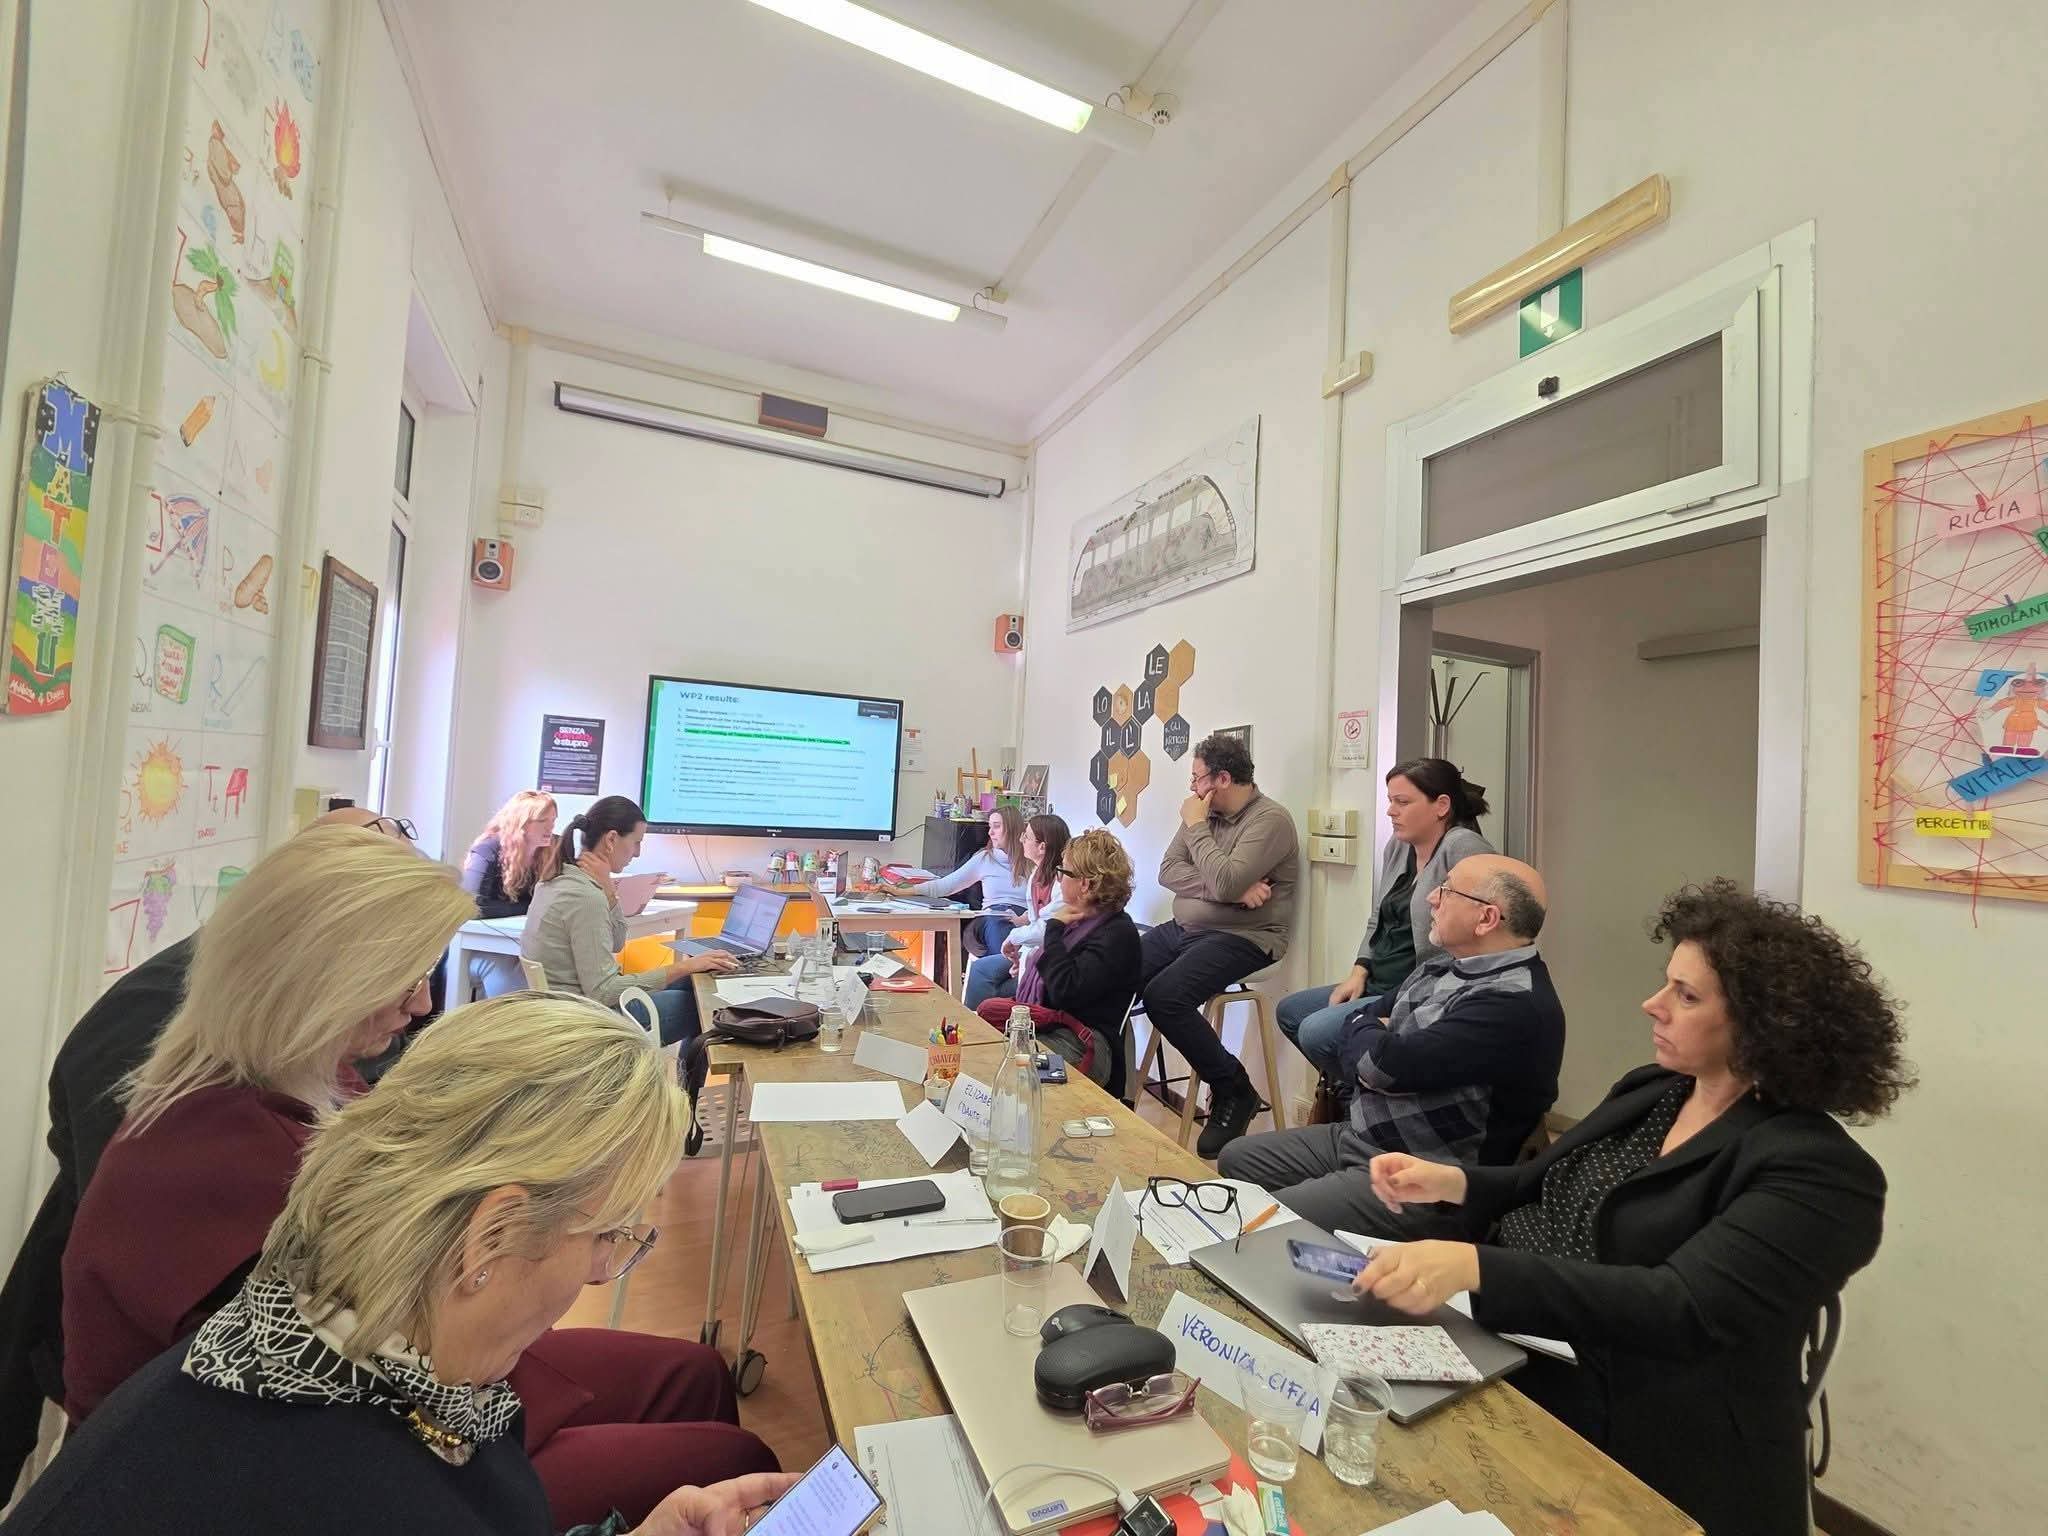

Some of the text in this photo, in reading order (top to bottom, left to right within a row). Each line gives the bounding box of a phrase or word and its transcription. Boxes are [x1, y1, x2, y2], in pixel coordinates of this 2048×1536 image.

[1949, 500, 2020, 530] RICCIA
[1148, 653, 1165, 676] LE
[680, 690, 703, 700] WP2
[1096, 695, 1108, 715] LO
[1137, 690, 1151, 711] LA
[1957, 757, 2041, 796] VITALE
[1181, 1313, 1255, 1376] VERONICA
[1031, 1502, 1065, 1518] Lenovo
